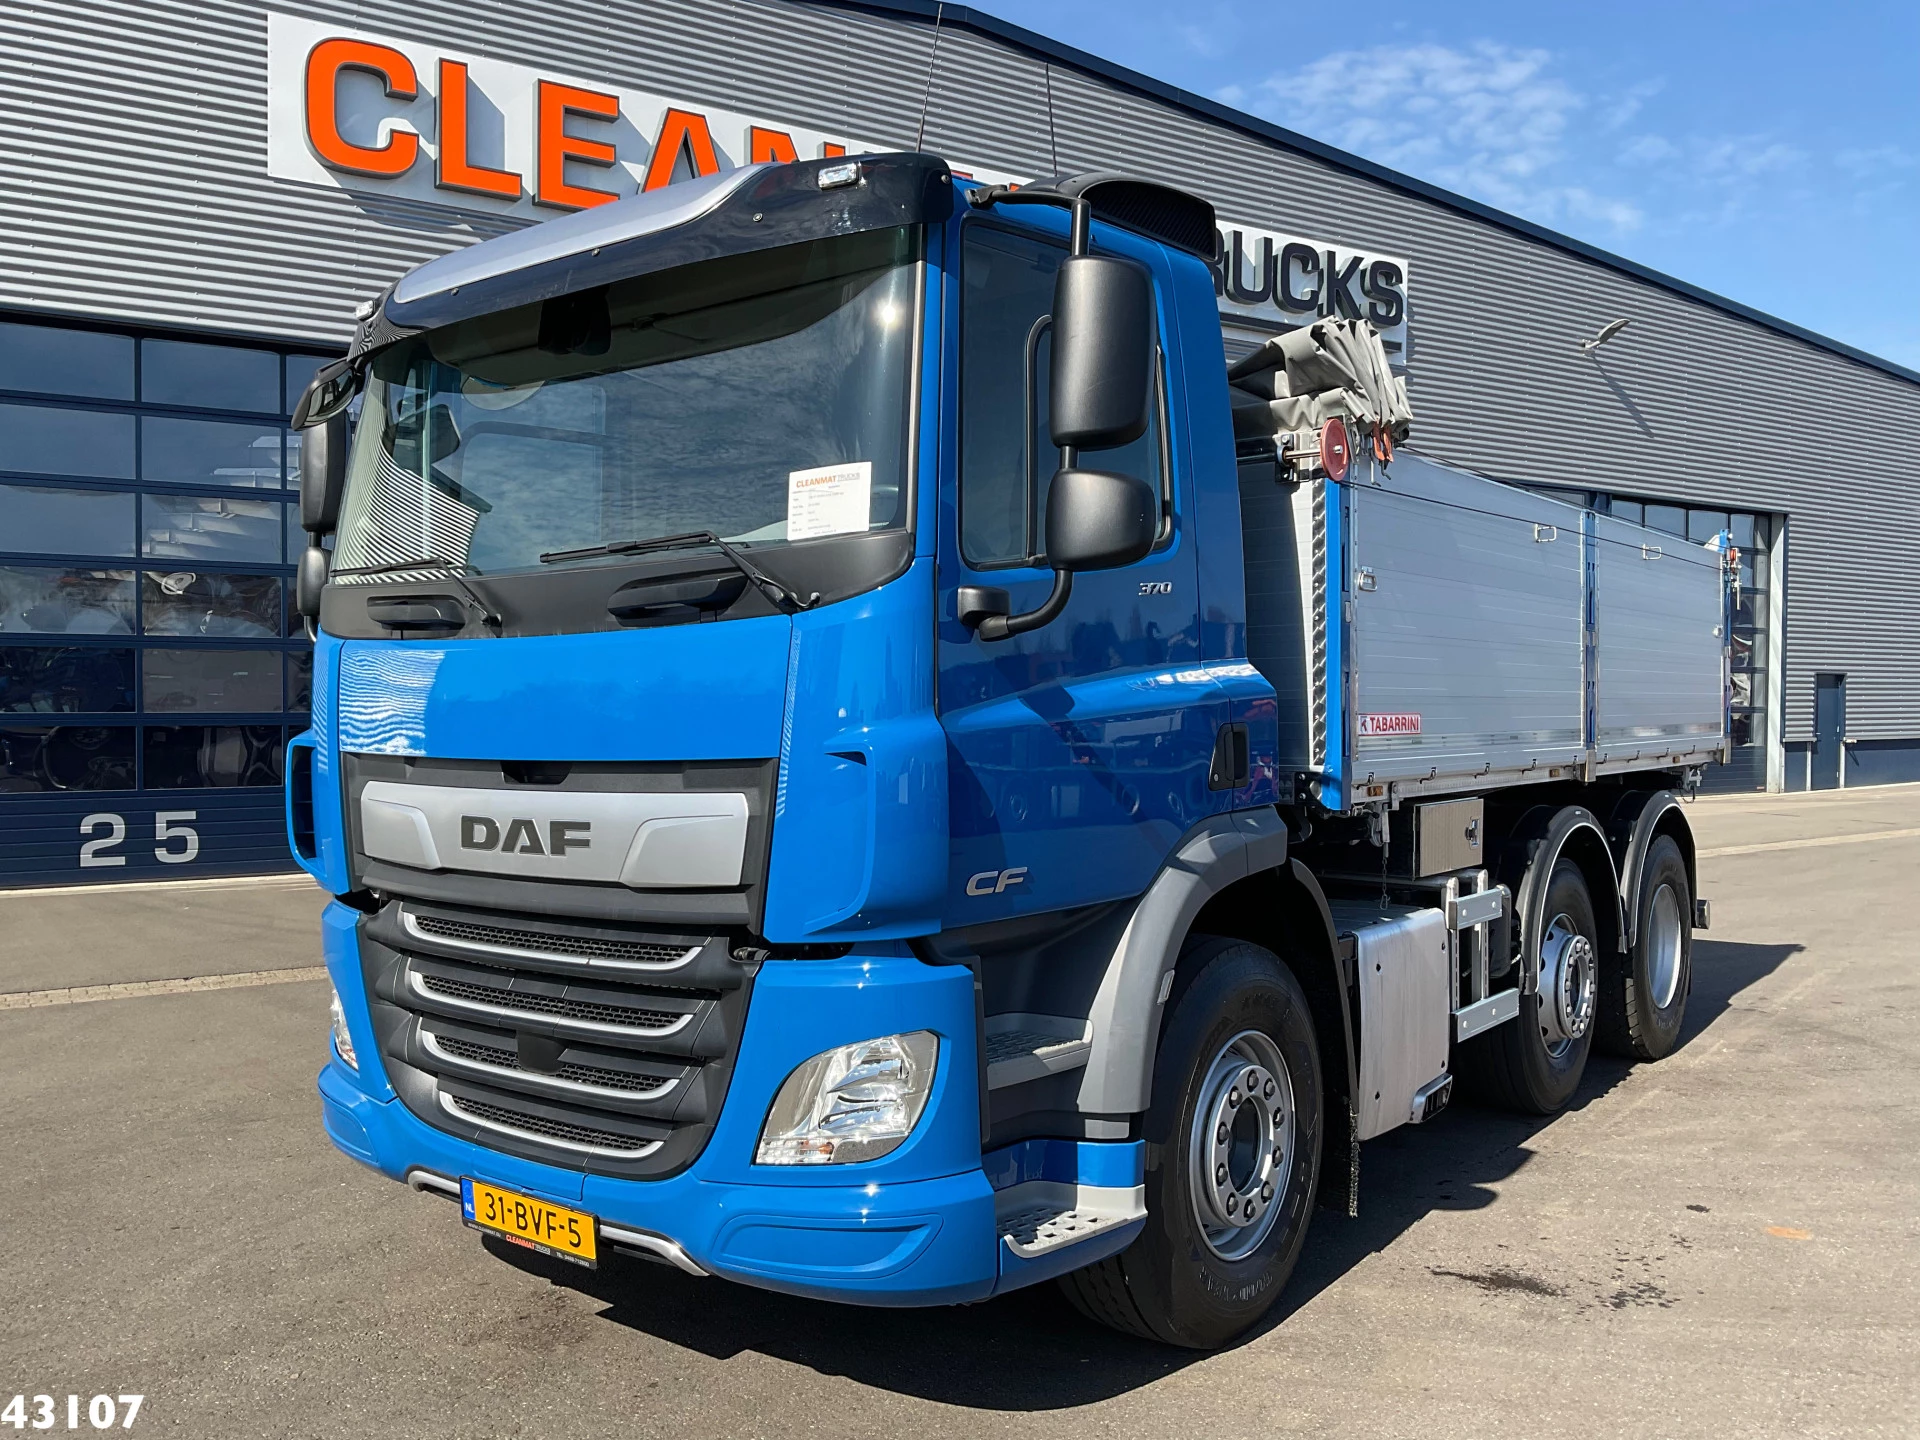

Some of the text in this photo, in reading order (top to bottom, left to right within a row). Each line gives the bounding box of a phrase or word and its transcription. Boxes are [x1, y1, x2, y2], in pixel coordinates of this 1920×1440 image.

[796, 475, 837, 488] CLEANMAT
[1138, 581, 1172, 596] 370
[1370, 716, 1419, 732] TABARRINI
[461, 814, 591, 857] DAF
[966, 866, 1028, 896] CF
[465, 1202, 474, 1213] NL
[485, 1191, 582, 1248] 31-BVF-5
[505, 1234, 535, 1250] CLEANMAT
